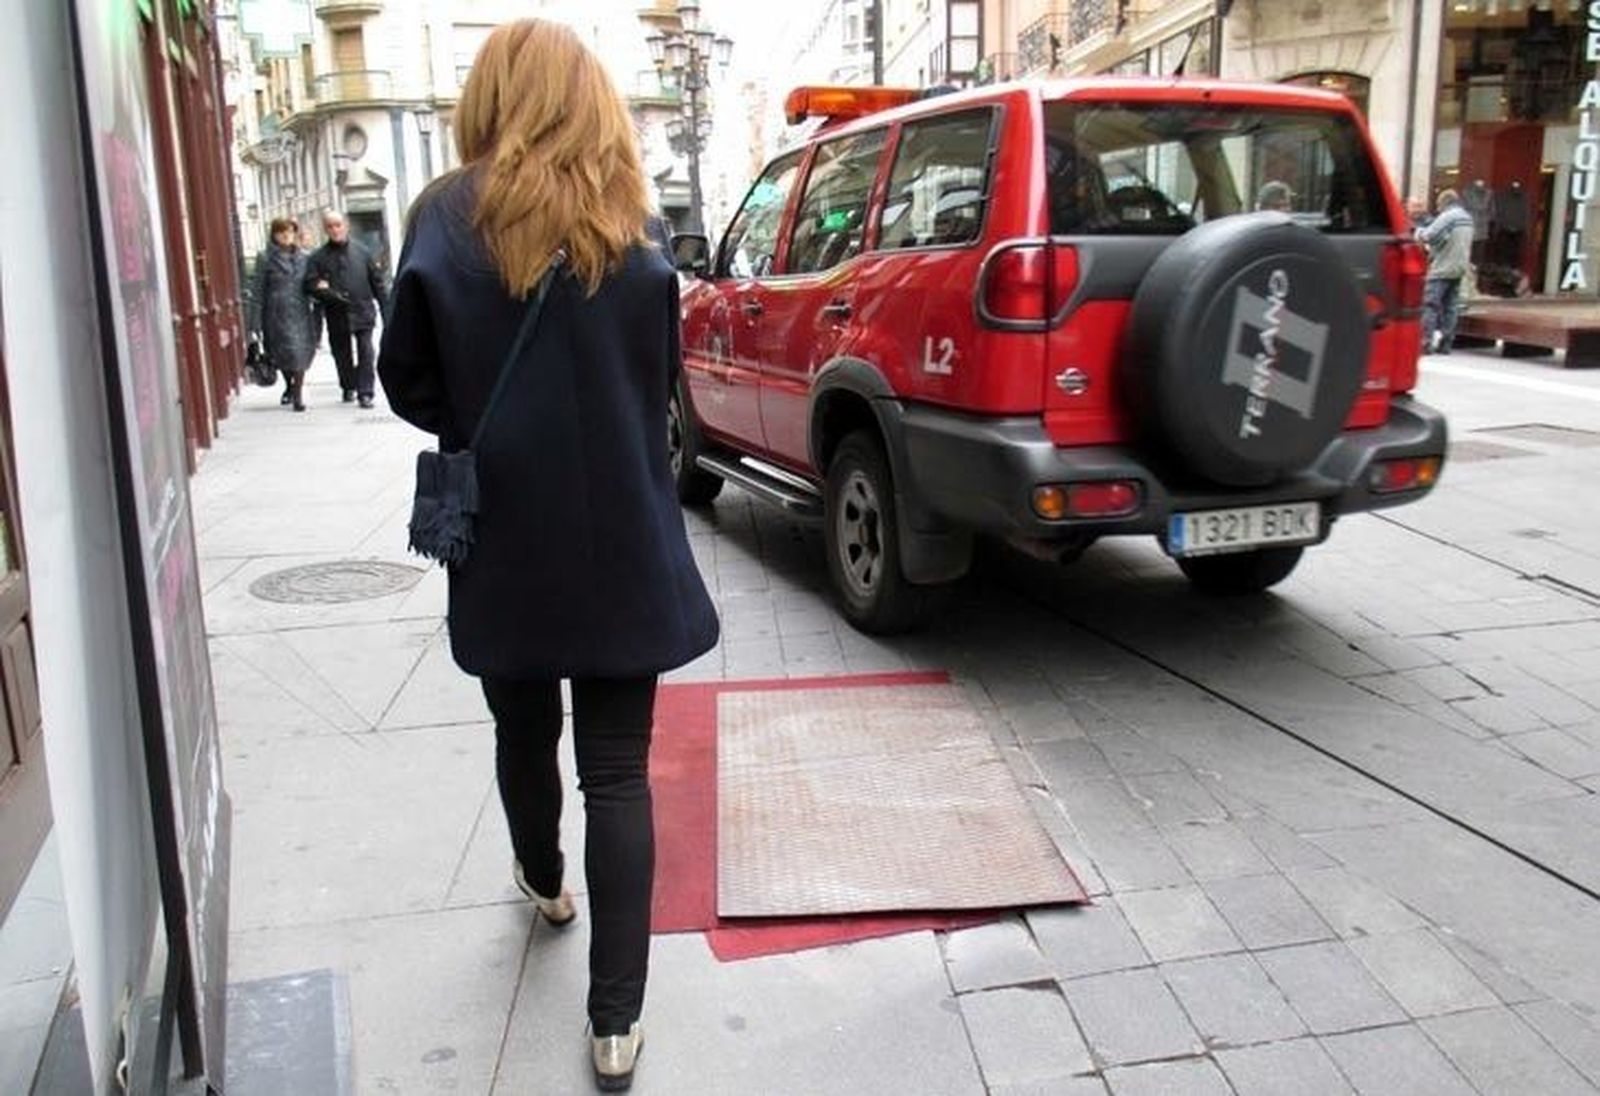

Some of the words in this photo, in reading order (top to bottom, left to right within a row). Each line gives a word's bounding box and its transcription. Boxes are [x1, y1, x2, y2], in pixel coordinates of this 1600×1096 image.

[1560, 80, 1600, 289] ALQUILA
[923, 335, 955, 375] L2
[1239, 269, 1289, 439] TERRANO
[1191, 512, 1252, 545] 1321
